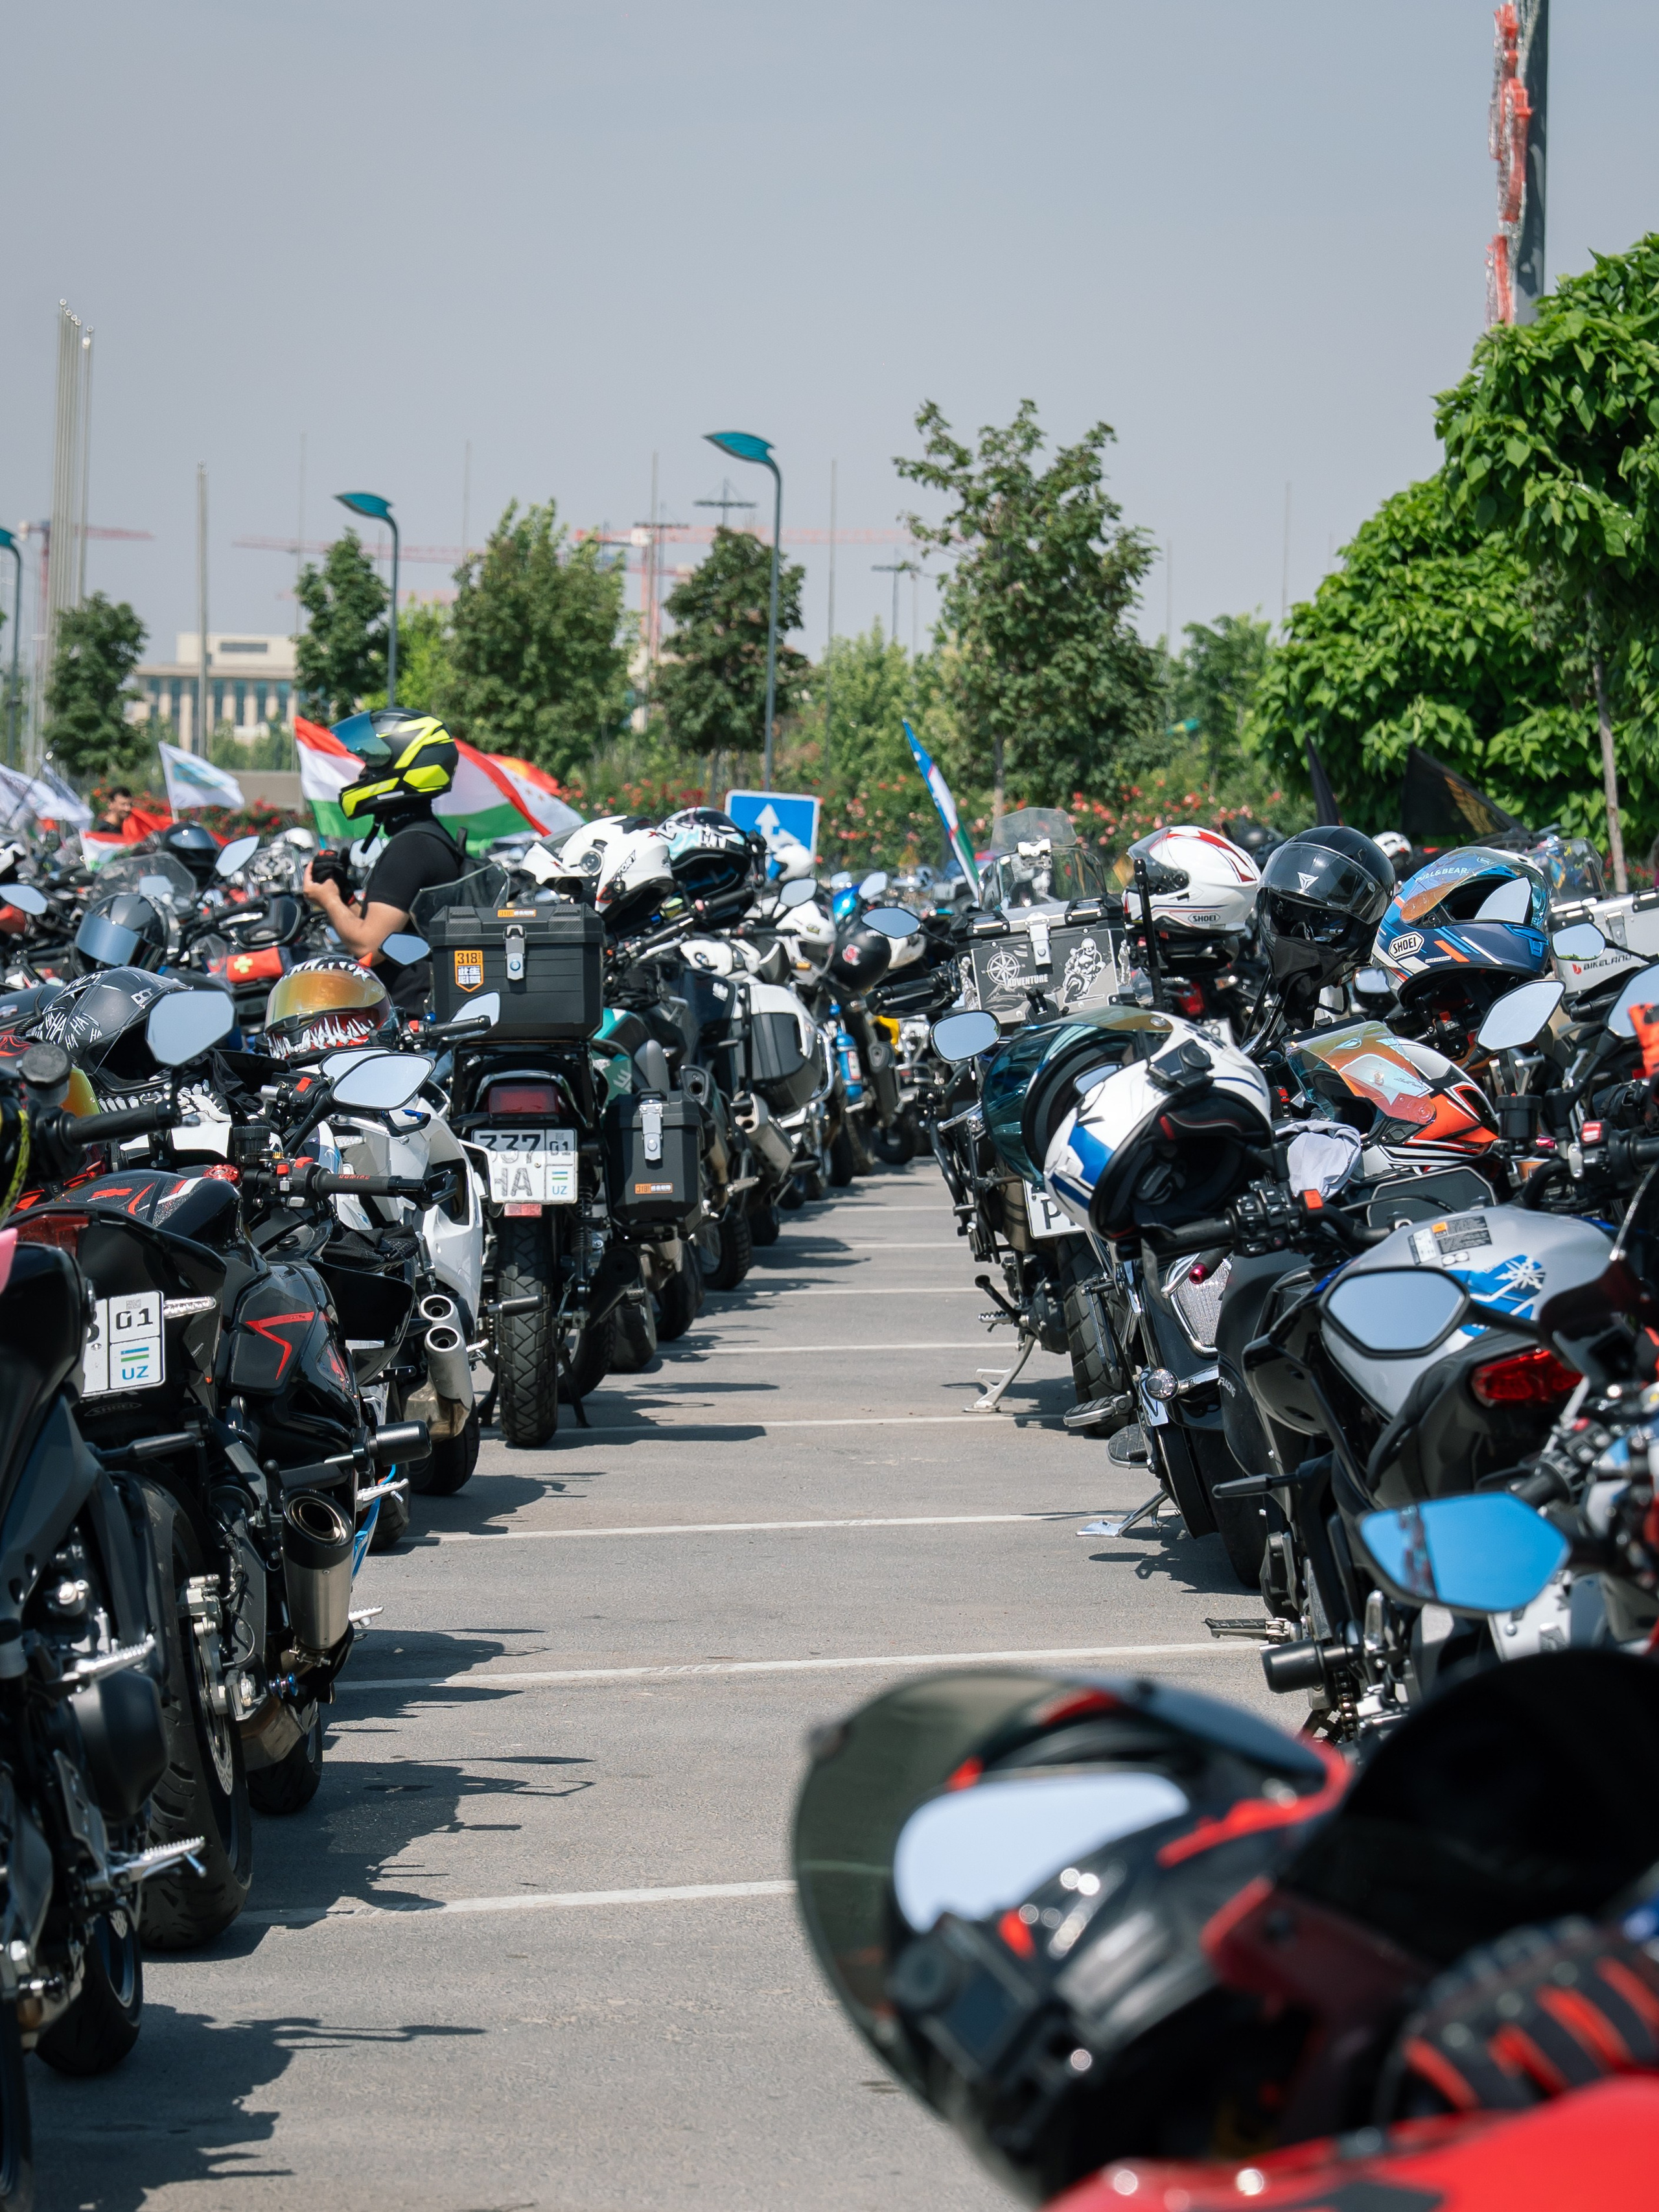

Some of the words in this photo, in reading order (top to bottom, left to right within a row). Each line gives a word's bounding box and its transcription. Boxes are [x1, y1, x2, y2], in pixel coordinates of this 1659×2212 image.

[1393, 937, 1417, 954] SHOEI
[458, 953, 478, 964] 318
[1007, 973, 1049, 987] ADVENTURE
[46, 1012, 67, 1044] HA
[70, 1016, 89, 1036] HA
[65, 1033, 79, 1052] HA
[90, 1028, 102, 1043] HA
[550, 1141, 571, 1156] 01
[552, 1185, 568, 1195] UZ
[116, 1308, 153, 1330] 01
[122, 1365, 149, 1380] UZ
